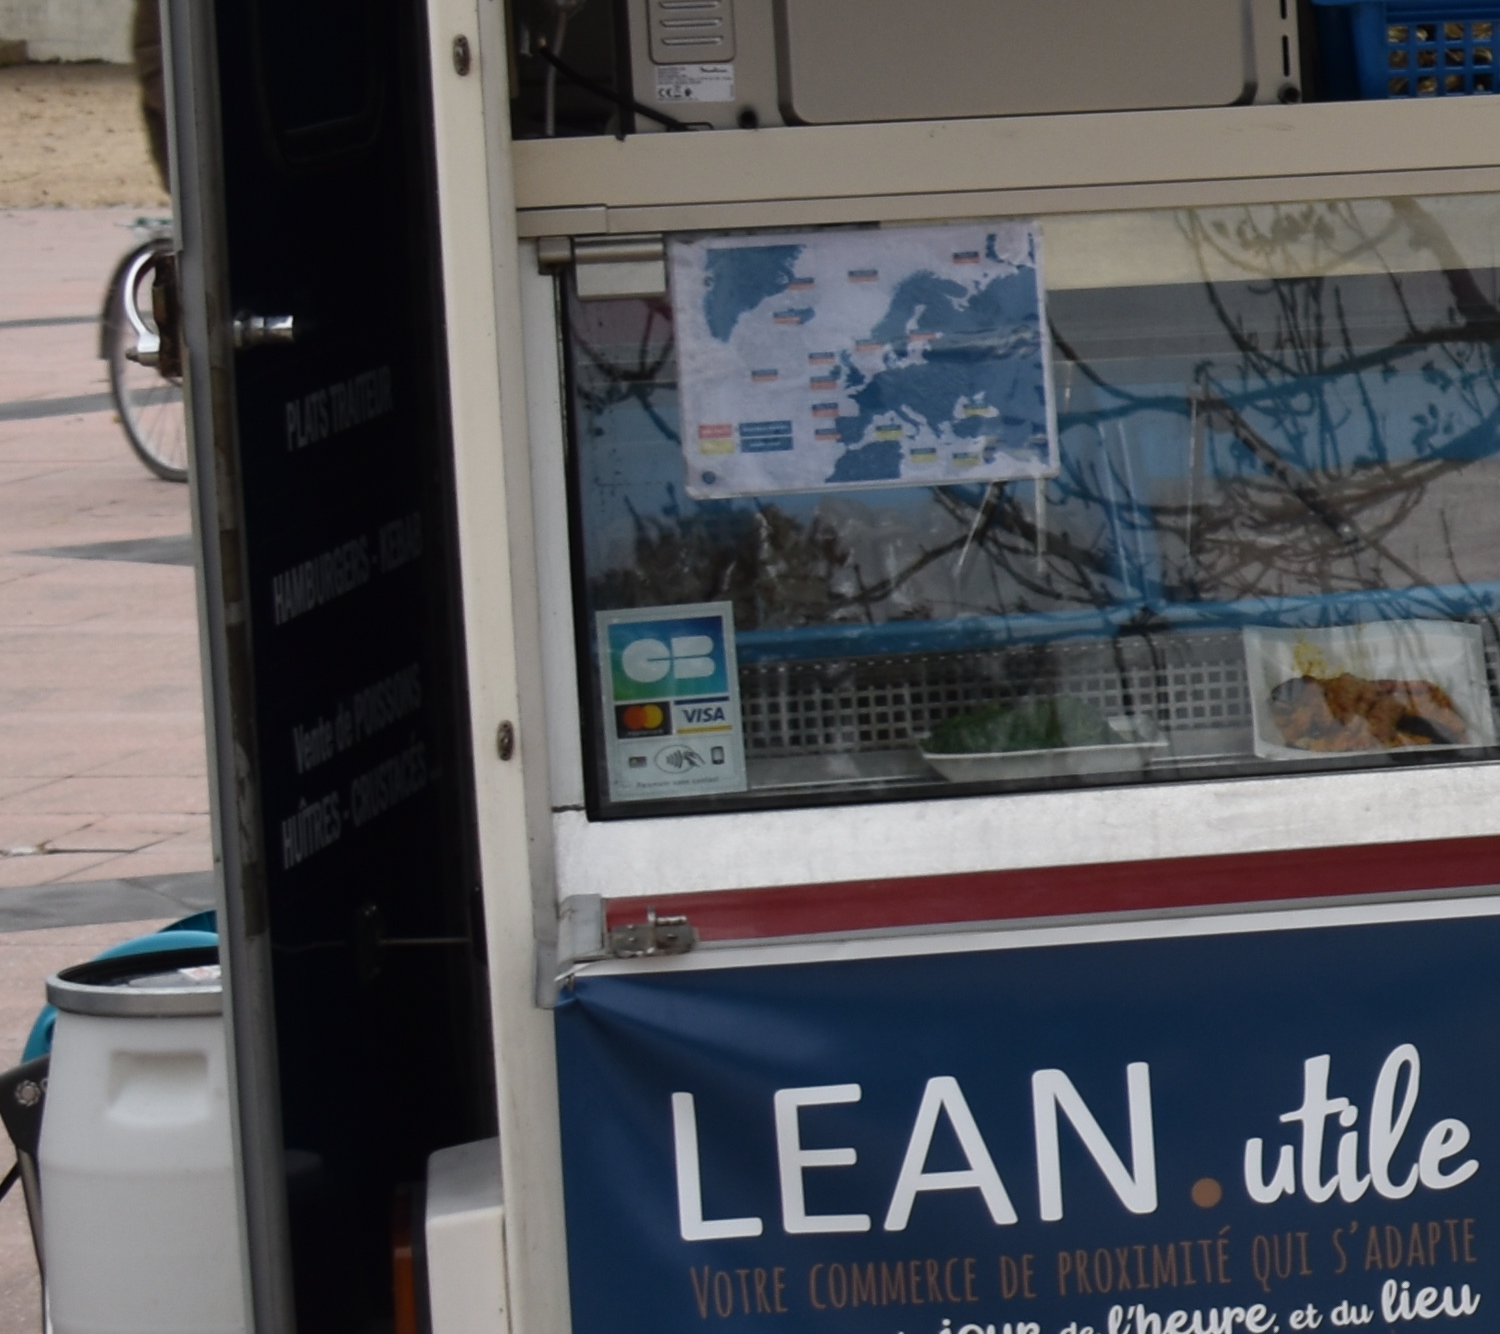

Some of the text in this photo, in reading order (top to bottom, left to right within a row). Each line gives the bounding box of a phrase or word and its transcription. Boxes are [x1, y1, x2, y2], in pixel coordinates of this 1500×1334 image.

[285, 365, 393, 452] PLATS TRAITEUR
[272, 511, 424, 627] HAMBURGERS KEBAB
[682, 707, 725, 723] VISA
[670, 1044, 1479, 1240] LEAN utile
[808, 1257, 978, 1310] COMMERCE
[1000, 1255, 1037, 1299] DE
[1058, 1227, 1231, 1297] PROXIMITÉ
[1252, 1232, 1312, 1293] QUI
[1331, 1217, 1477, 1273] S'ADAPTE
[1288, 1302, 1321, 1331] et
[1329, 1296, 1375, 1327] du
[1380, 1278, 1481, 1323] lieu
